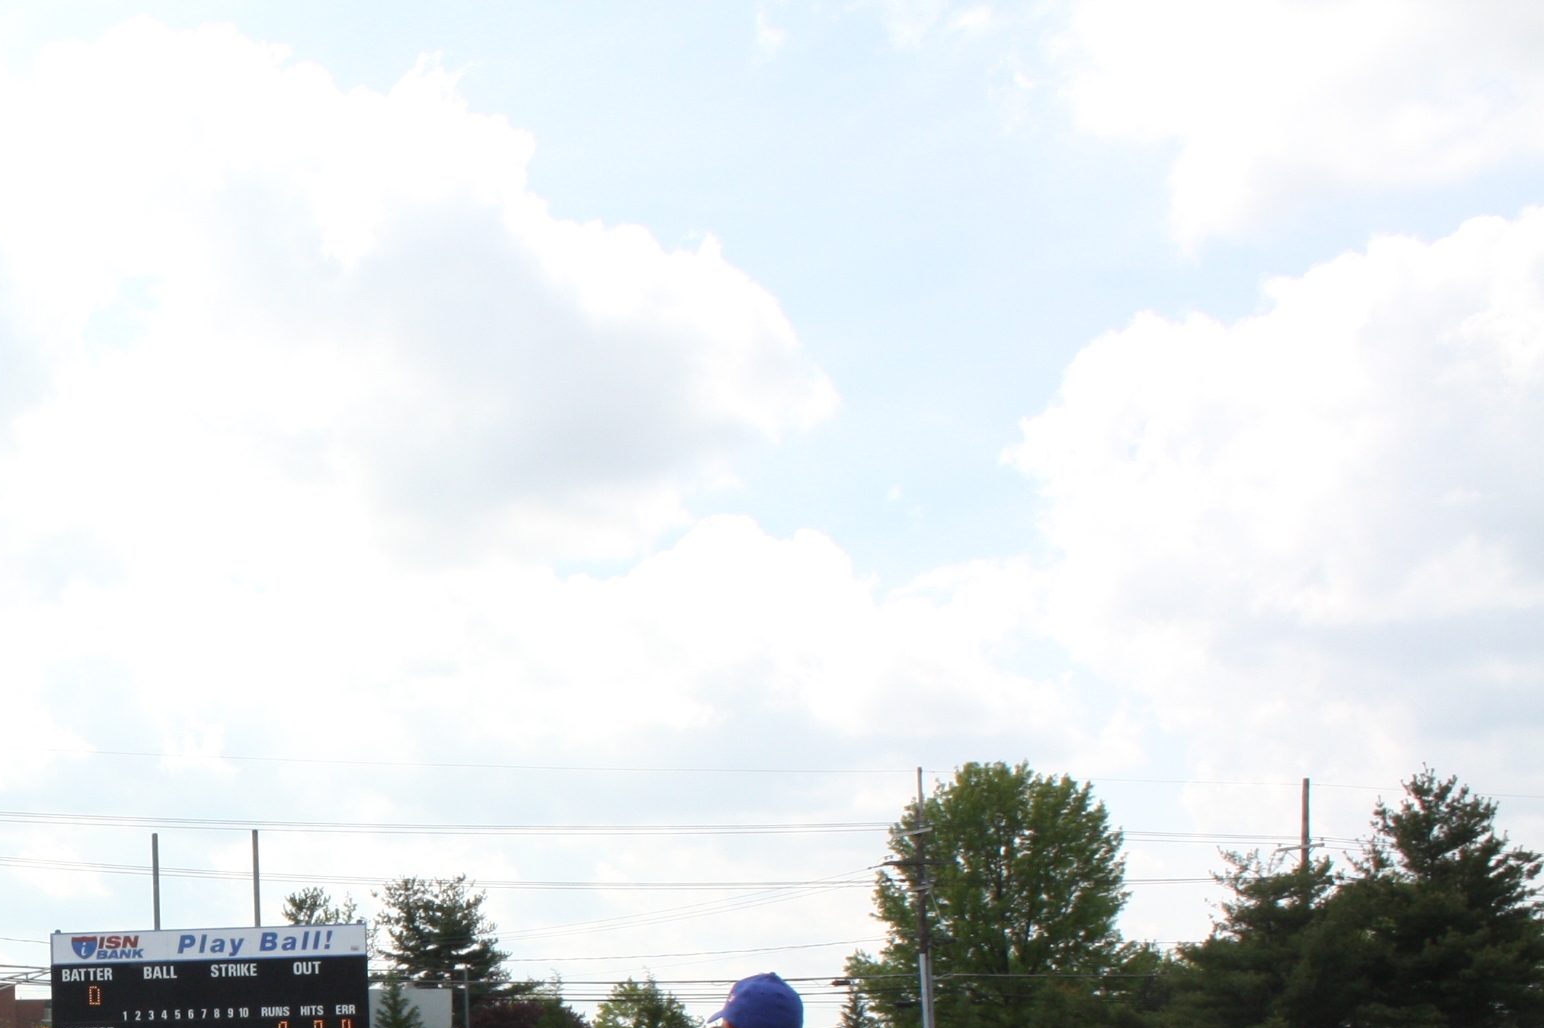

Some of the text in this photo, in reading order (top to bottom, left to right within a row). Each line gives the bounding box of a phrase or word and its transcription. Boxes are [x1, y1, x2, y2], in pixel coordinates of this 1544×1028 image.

[98, 936, 139, 950] ISN
[177, 930, 333, 956] Play Ball!
[96, 948, 144, 960] BANK
[62, 968, 112, 982] BATTER
[143, 966, 178, 980] BALL
[210, 963, 258, 977] STRIKE
[292, 961, 321, 975] OUT
[123, 1007, 249, 1021] 1 2 3 4 5 6 7 8 9 10
[261, 1006, 290, 1017] RUNS
[300, 1005, 324, 1016] HITS
[336, 1004, 356, 1015] ERR
